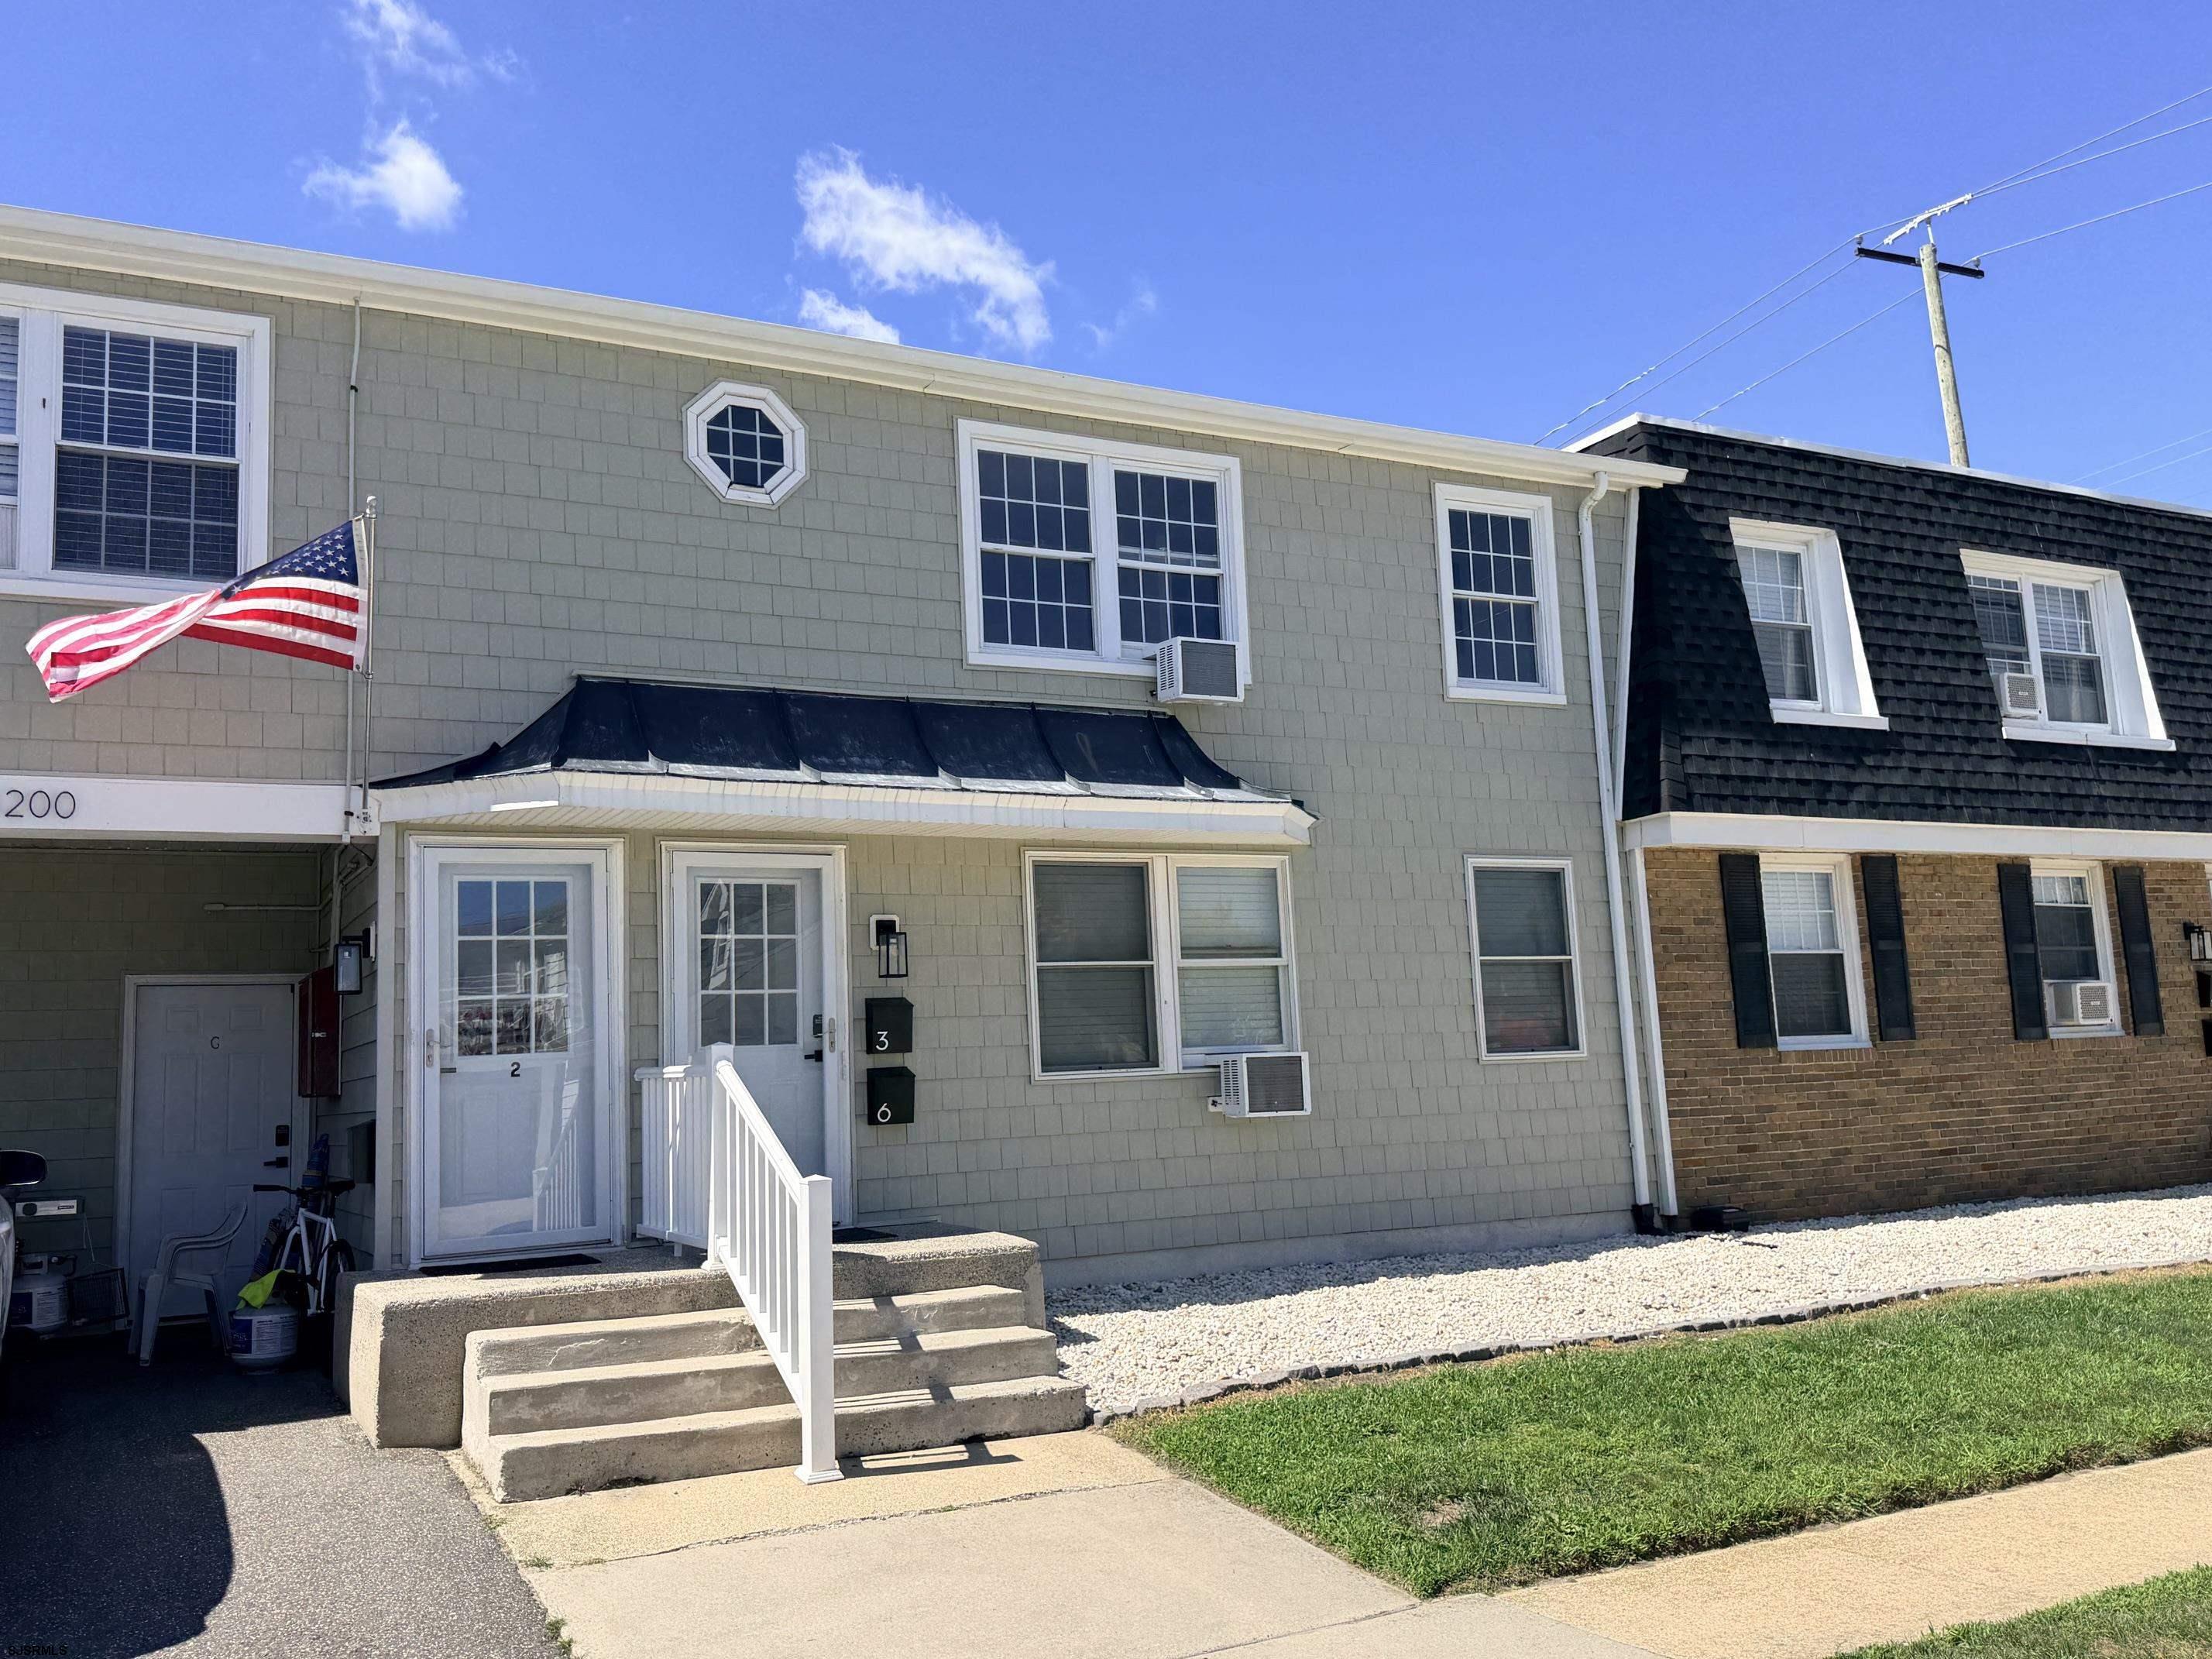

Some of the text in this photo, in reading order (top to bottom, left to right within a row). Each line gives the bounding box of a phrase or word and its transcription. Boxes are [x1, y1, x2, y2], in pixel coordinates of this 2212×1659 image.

[5, 789, 76, 819] 200
[876, 1031, 888, 1050] 3
[510, 1061, 520, 1077] 2
[877, 1103, 891, 1122] 6
